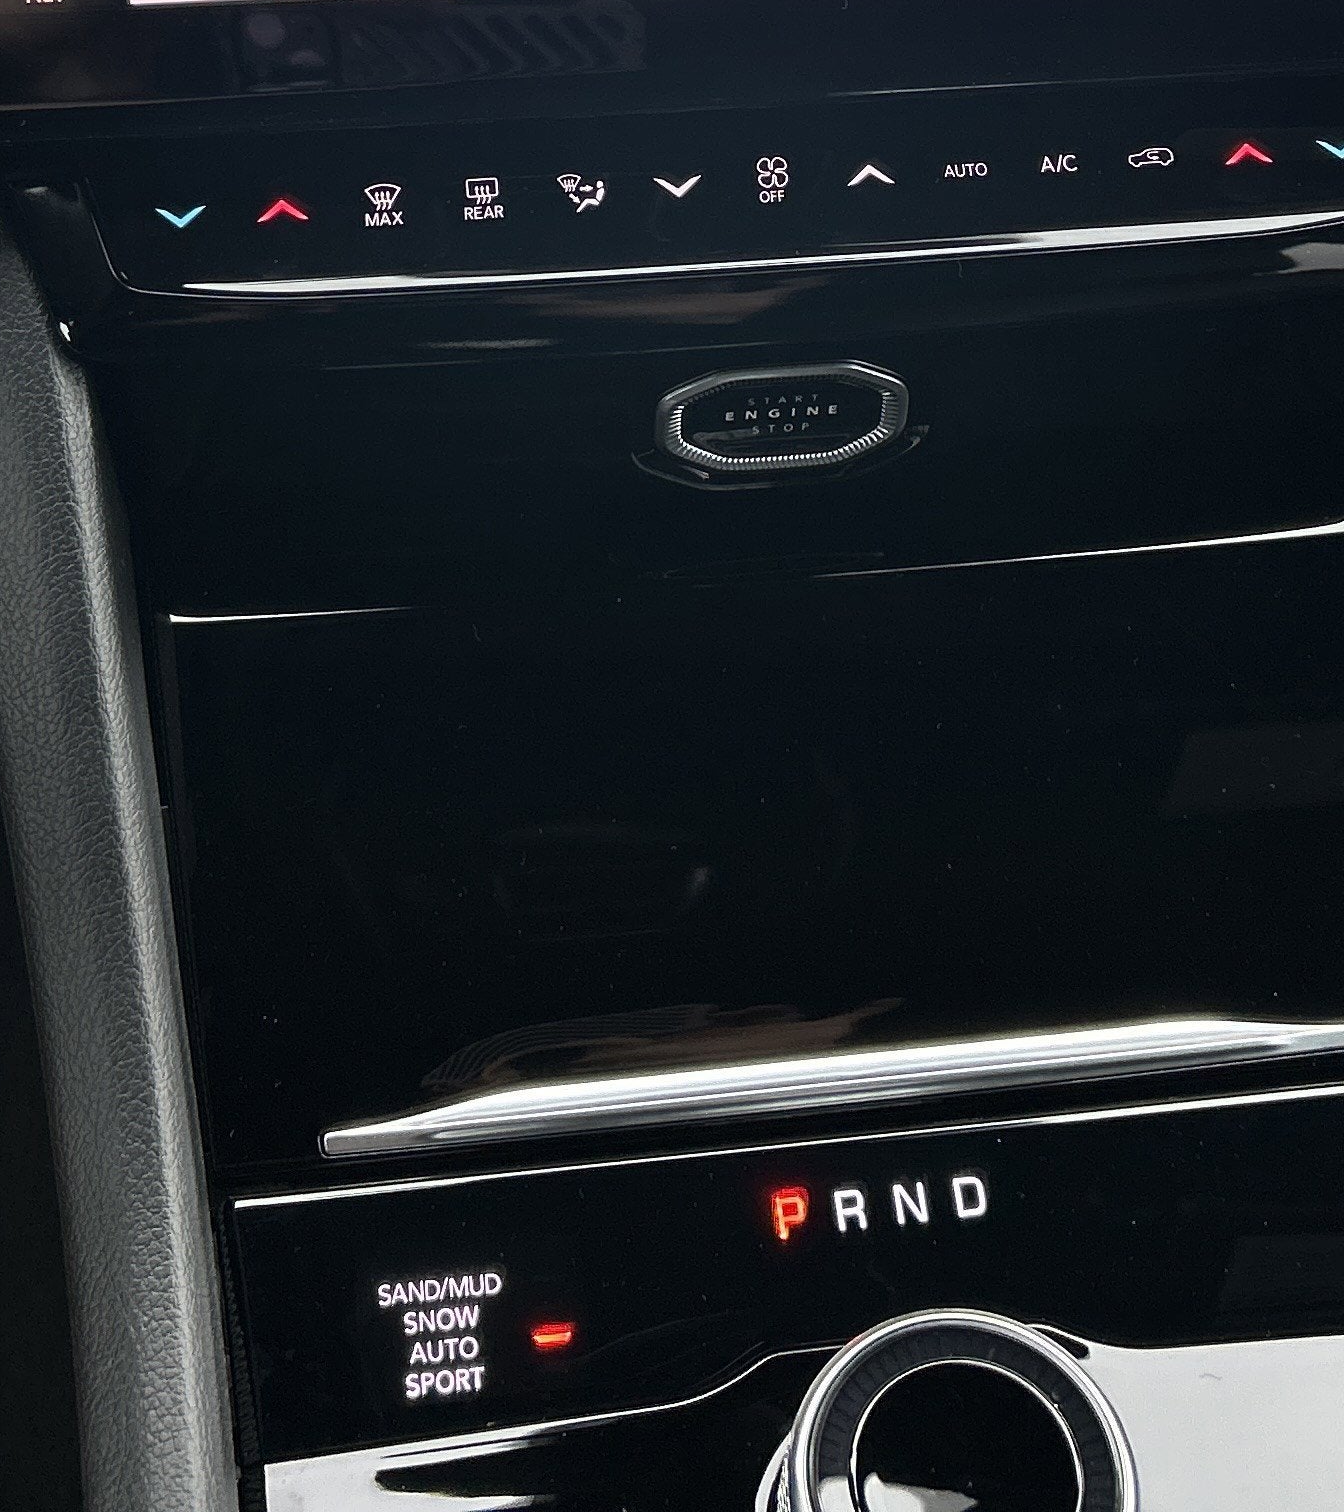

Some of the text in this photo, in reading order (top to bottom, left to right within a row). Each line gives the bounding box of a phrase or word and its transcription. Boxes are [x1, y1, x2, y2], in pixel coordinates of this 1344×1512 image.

[944, 162, 988, 178] AUTO
[1040, 154, 1078, 174] A/C
[759, 190, 785, 204] OFF
[364, 211, 404, 228] MAX
[464, 204, 504, 221] REAR
[748, 392, 819, 407] START
[725, 404, 839, 423] ENGINE
[752, 422, 810, 436] STOP
[771, 1175, 987, 1242] P R N D
[377, 1272, 504, 1307] SAND/MUD
[403, 1305, 480, 1336] SNOW
[409, 1336, 479, 1366] AUTO
[405, 1366, 485, 1399] SPORT
